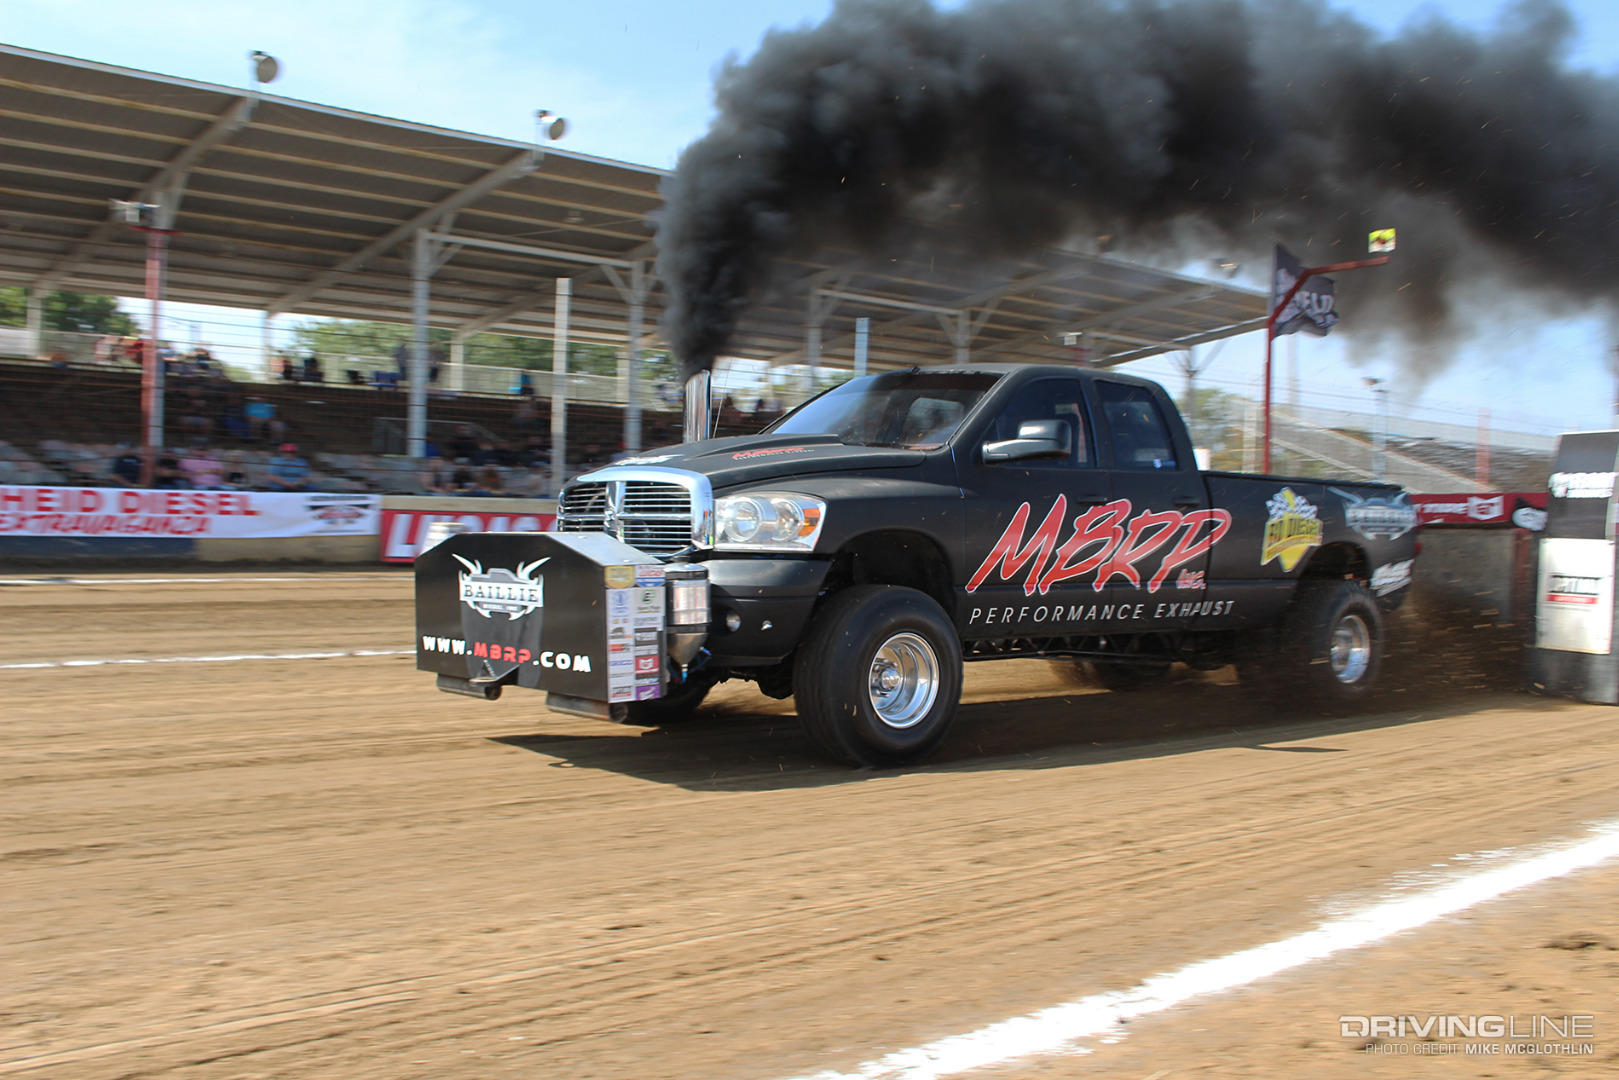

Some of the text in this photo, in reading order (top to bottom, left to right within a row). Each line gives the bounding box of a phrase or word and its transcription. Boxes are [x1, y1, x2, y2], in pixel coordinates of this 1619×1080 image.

[119, 490, 260, 516] DIESEL
[0, 513, 213, 535] EXTRAVAGANZA
[965, 493, 1232, 596] MBRP
[463, 584, 539, 602] BAILLIE
[969, 600, 1235, 624] PERFORMANCE EXHAUST
[422, 635, 592, 673] WWW.MBRP.COM
